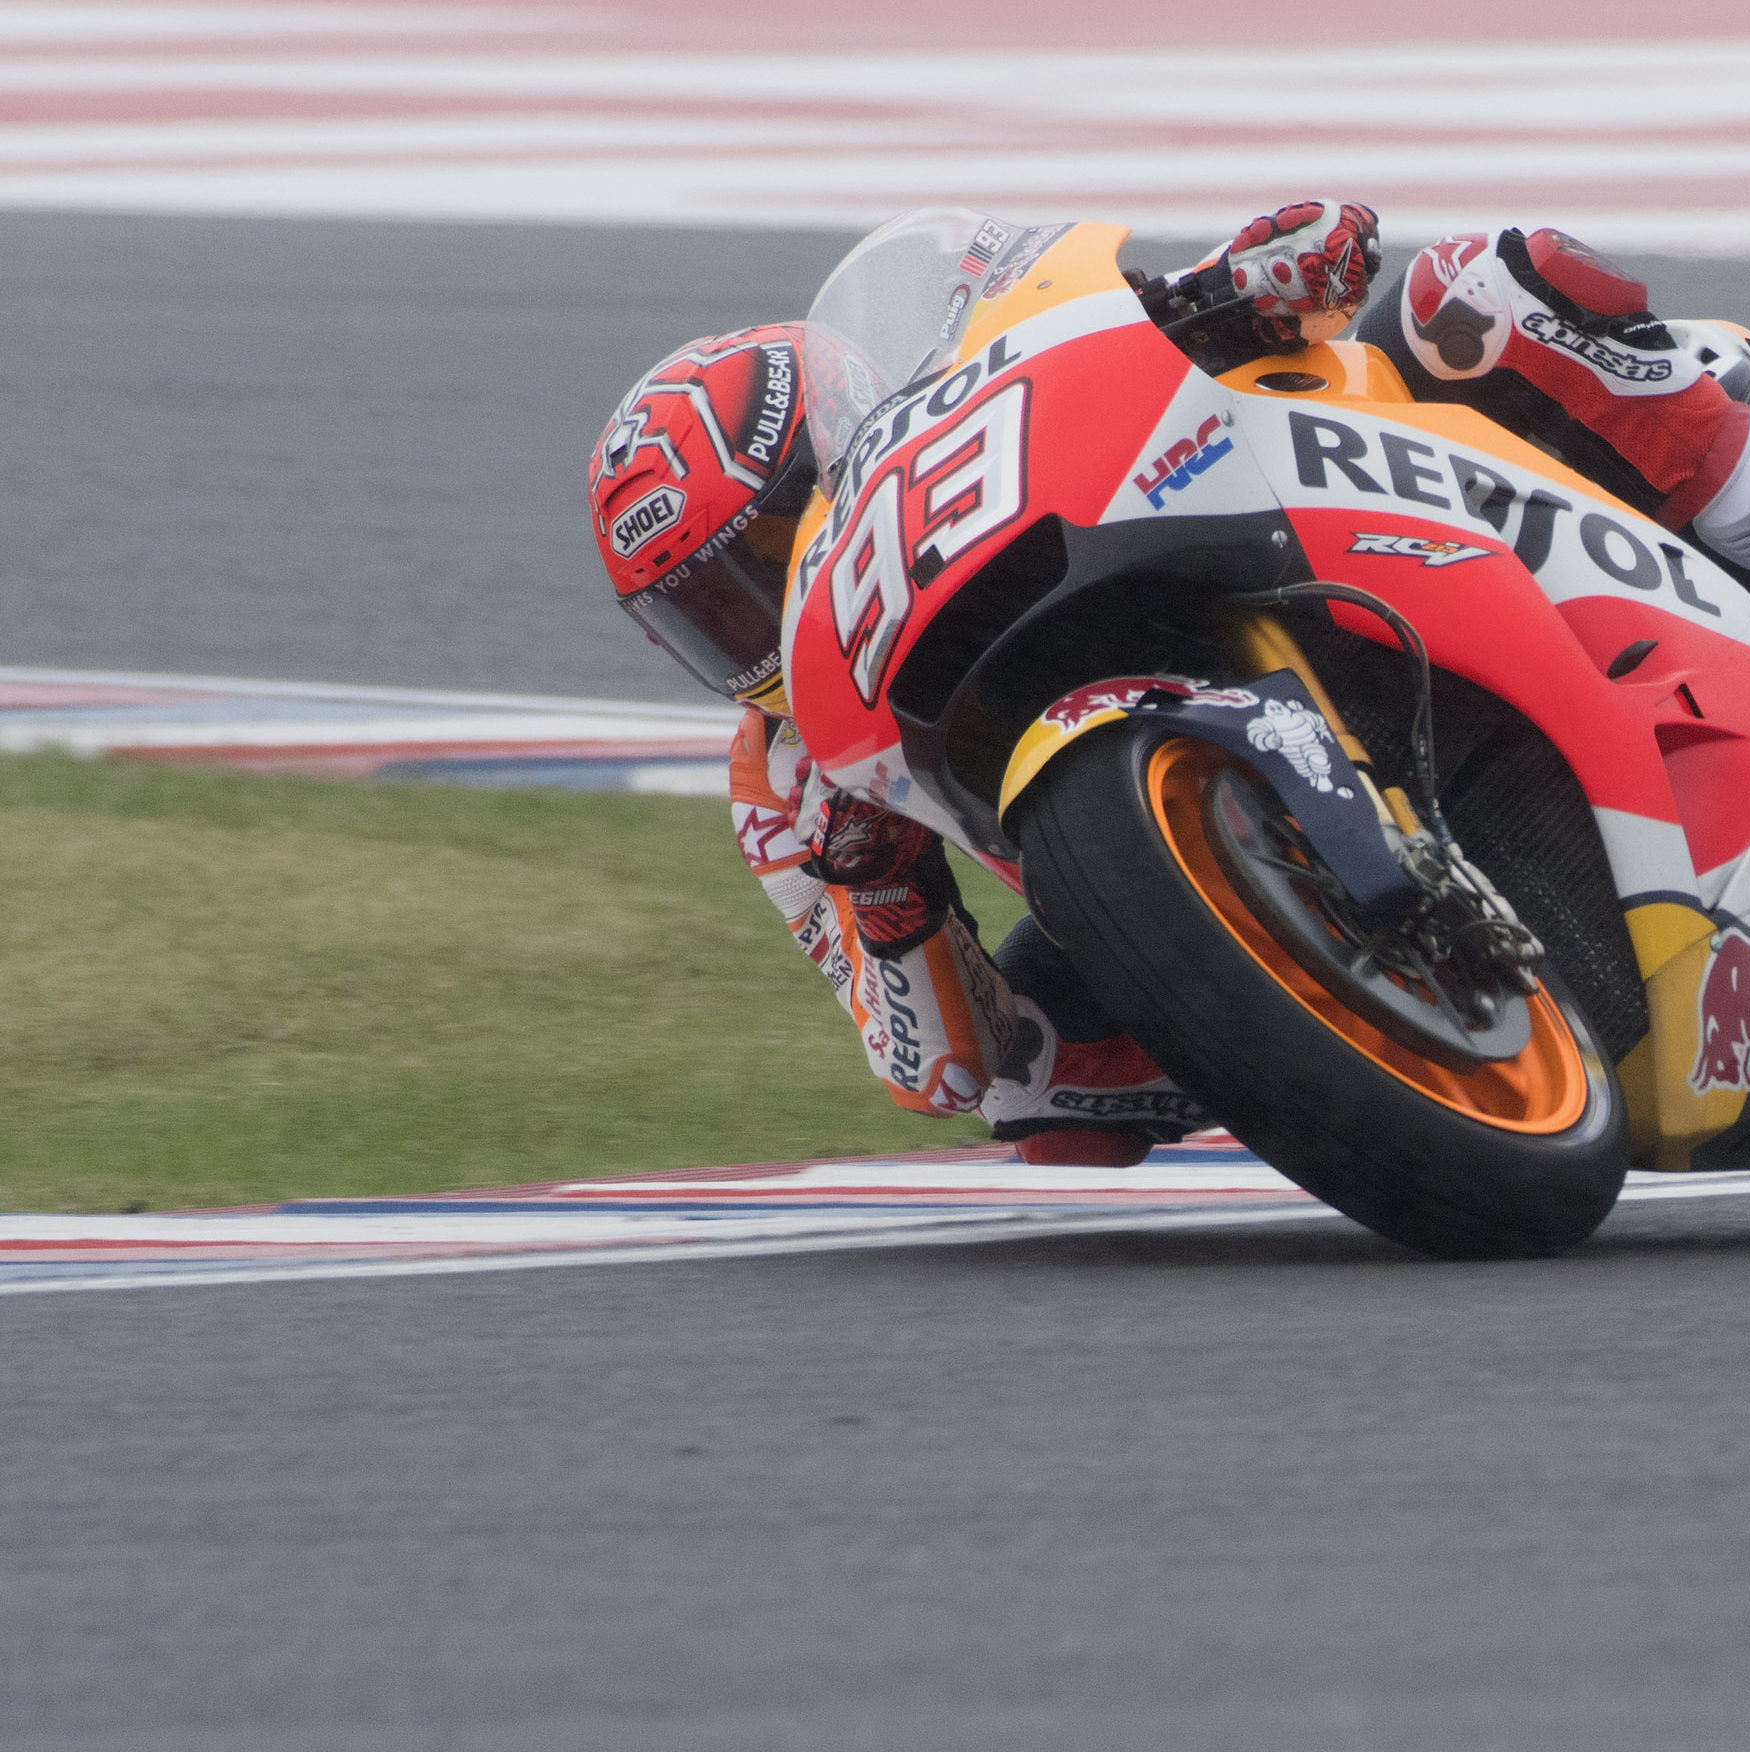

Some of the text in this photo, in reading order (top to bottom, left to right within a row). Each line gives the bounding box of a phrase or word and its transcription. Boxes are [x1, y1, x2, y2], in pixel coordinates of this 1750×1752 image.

[975, 219, 1010, 252] 93
[939, 294, 965, 340] Puig
[747, 348, 790, 462] PULL&BEAR
[800, 335, 1022, 602] REPSOL
[1133, 414, 1234, 511] HRC
[616, 493, 675, 551] SHOEI
[656, 564, 691, 594] YOU
[695, 506, 760, 562] WINGS
[830, 377, 1032, 711] 93
[1288, 410, 1721, 618] REPSOL
[726, 646, 782, 691] PULL&BE
[879, 957, 920, 1093] REPSO
